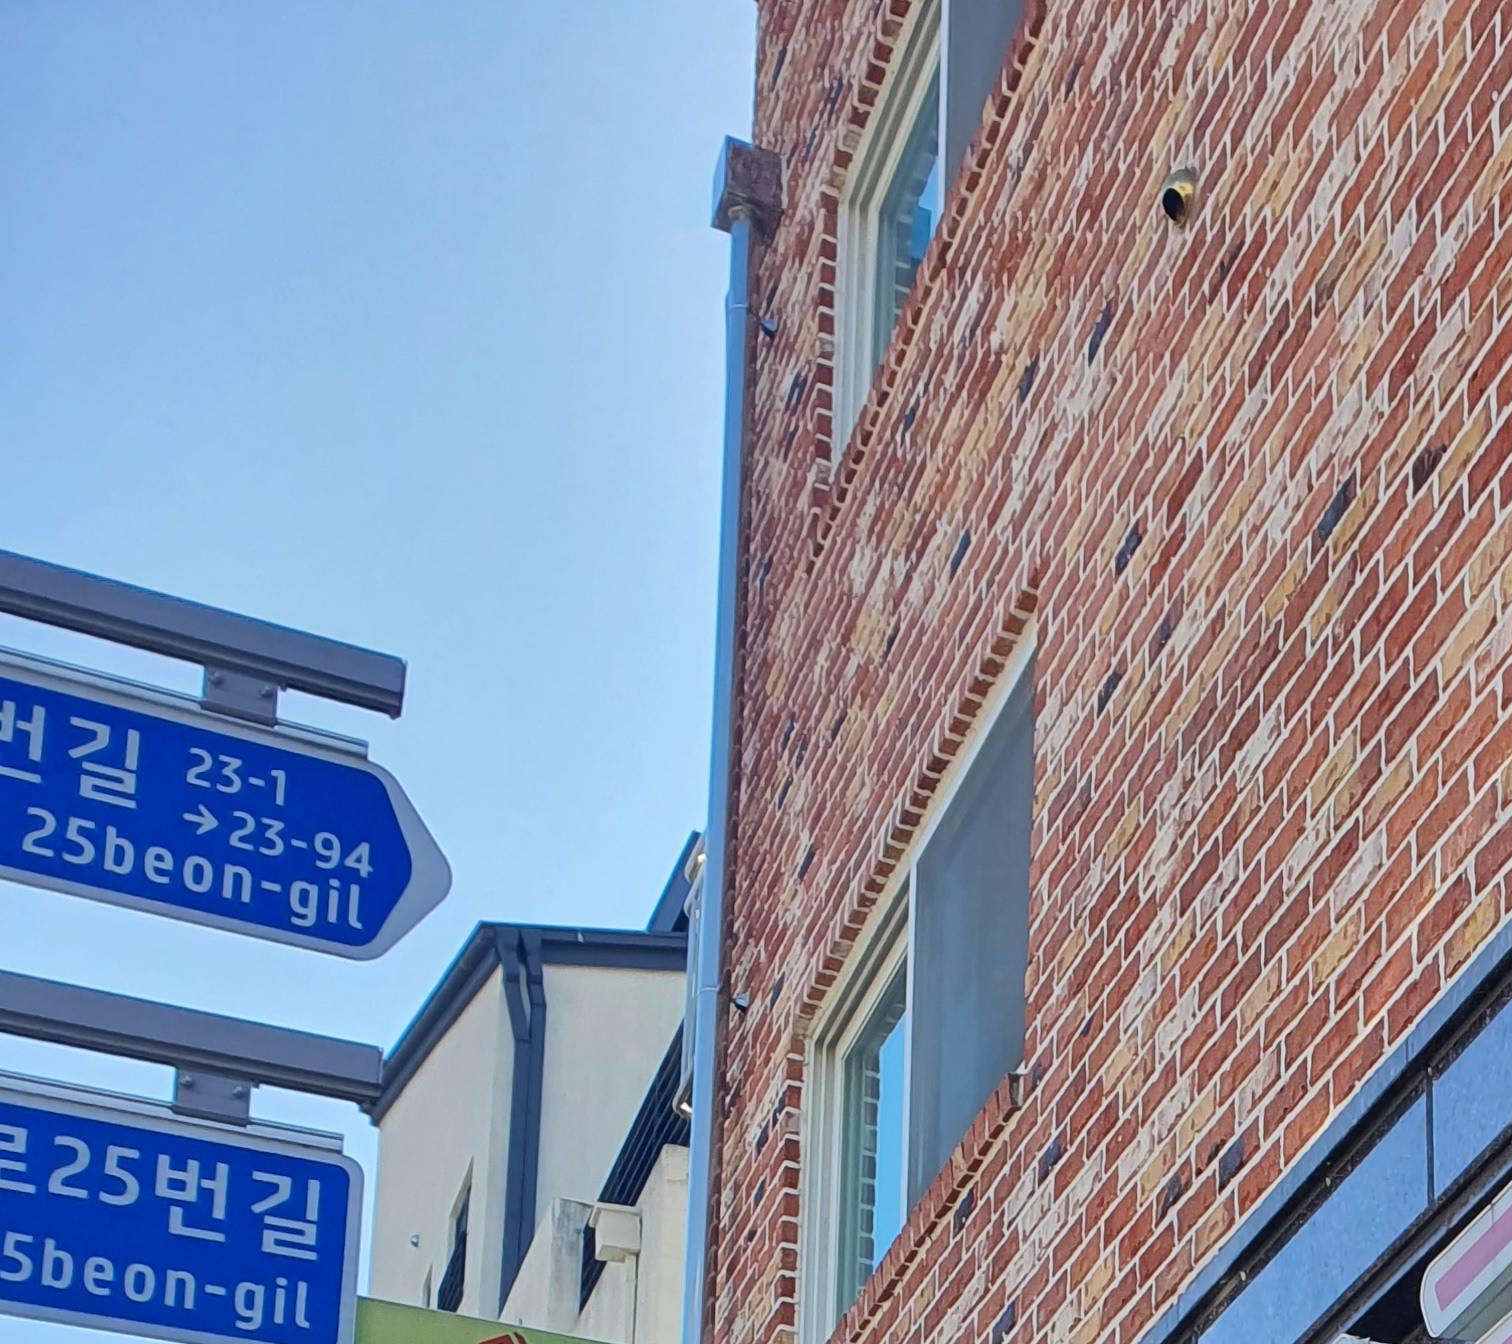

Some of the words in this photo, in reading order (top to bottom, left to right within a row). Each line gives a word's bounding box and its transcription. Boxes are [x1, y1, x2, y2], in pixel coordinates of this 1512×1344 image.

[185, 747, 287, 807] 23-1
[22, 806, 364, 931] 25beon-gil
[228, 810, 374, 879] 23-94
